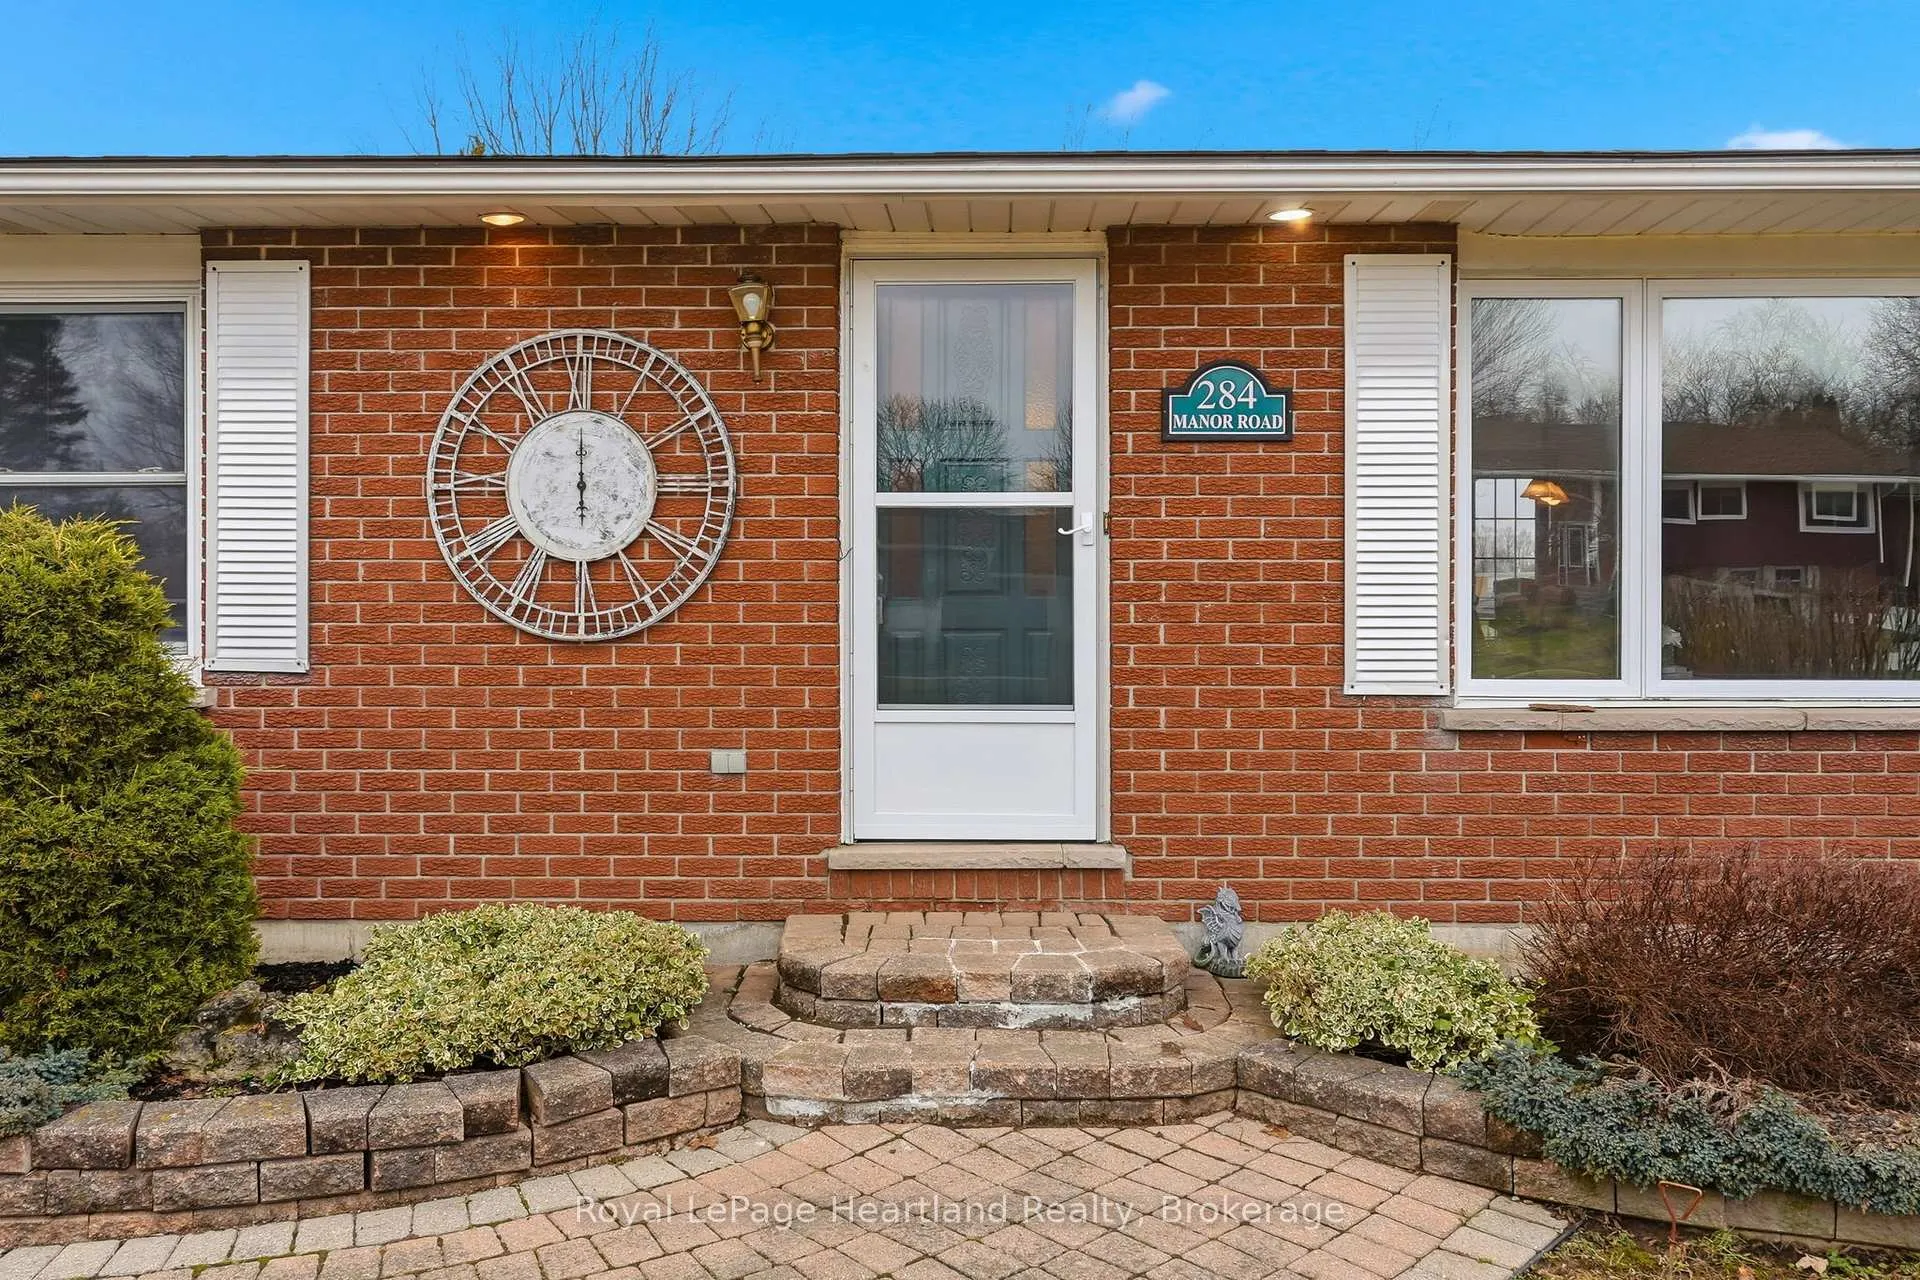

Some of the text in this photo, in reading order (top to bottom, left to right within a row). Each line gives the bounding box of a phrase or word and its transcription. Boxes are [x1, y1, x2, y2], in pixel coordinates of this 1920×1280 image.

[1196, 380, 1258, 410] 284
[1173, 414, 1283, 429] MANOR ROAD
